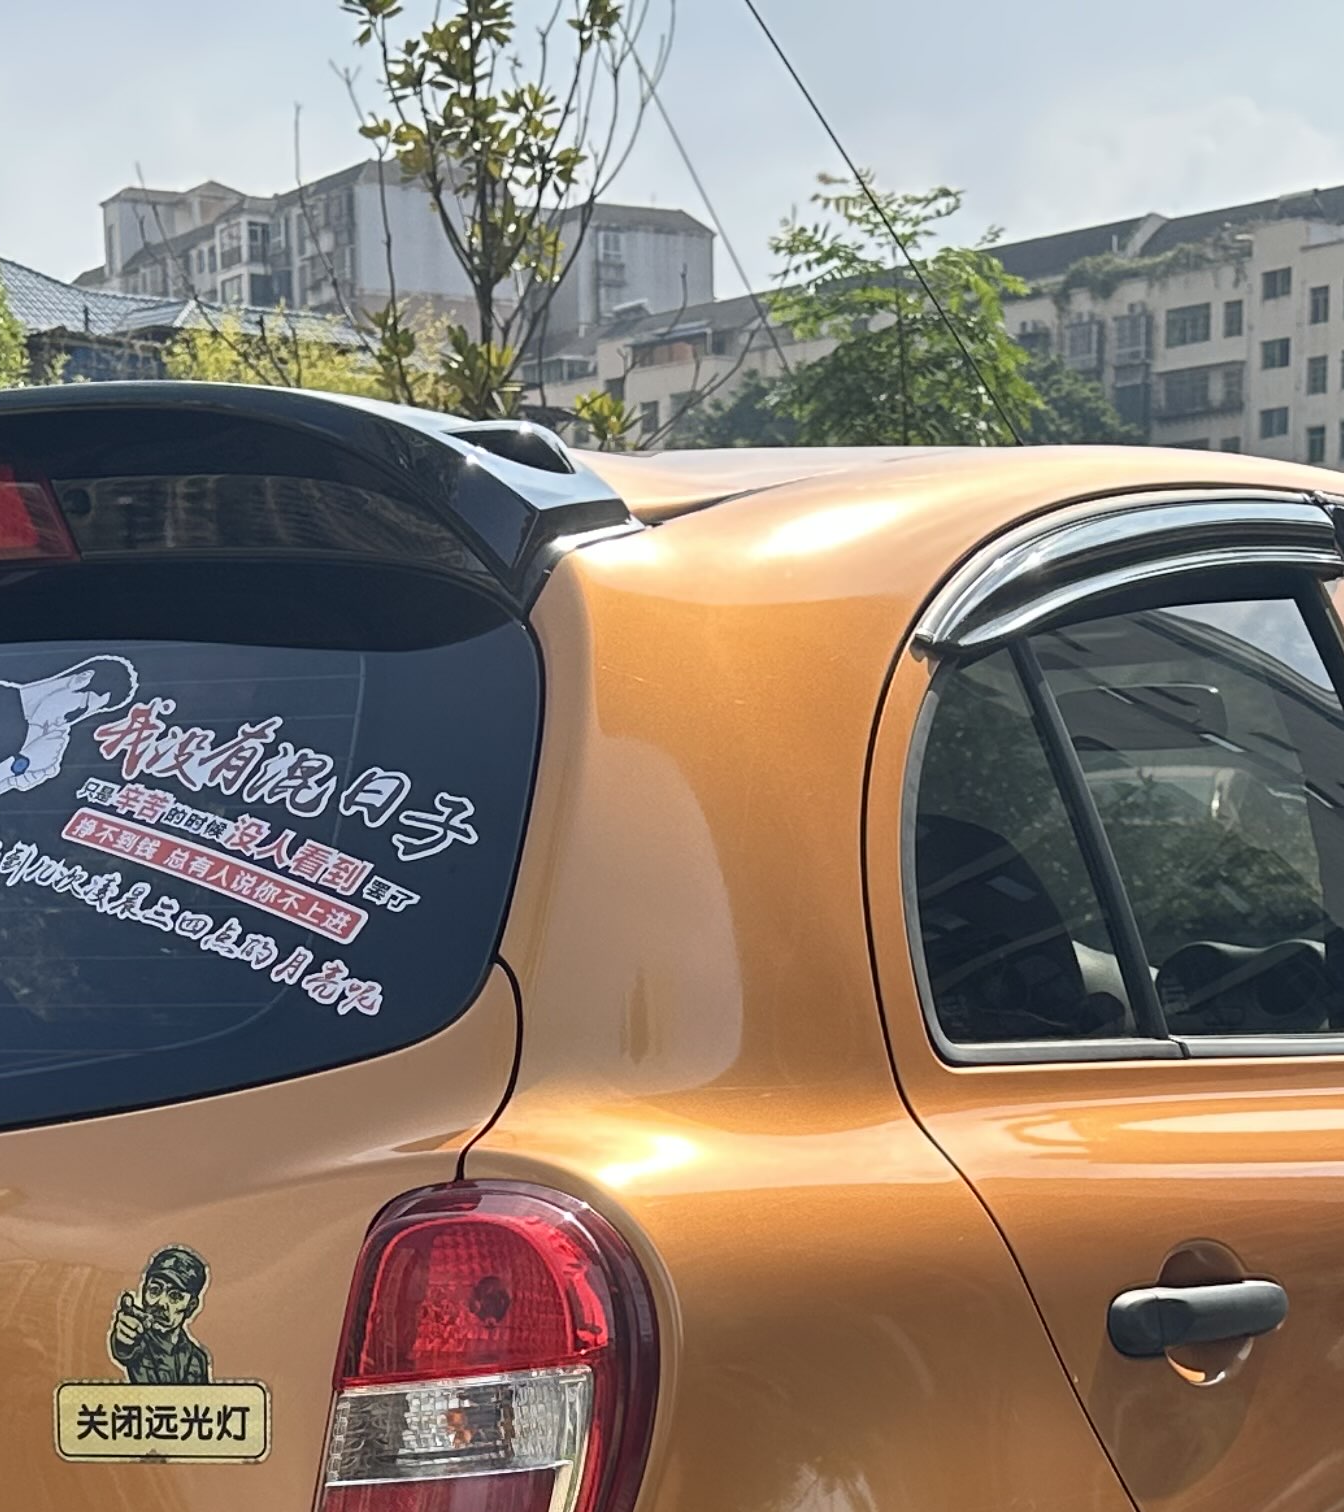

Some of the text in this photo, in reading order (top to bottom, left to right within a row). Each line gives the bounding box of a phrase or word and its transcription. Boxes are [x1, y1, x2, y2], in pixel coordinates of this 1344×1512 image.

[94, 698, 478, 861] 我没有混日子
[76, 1403, 250, 1442] 关闭远光灯
